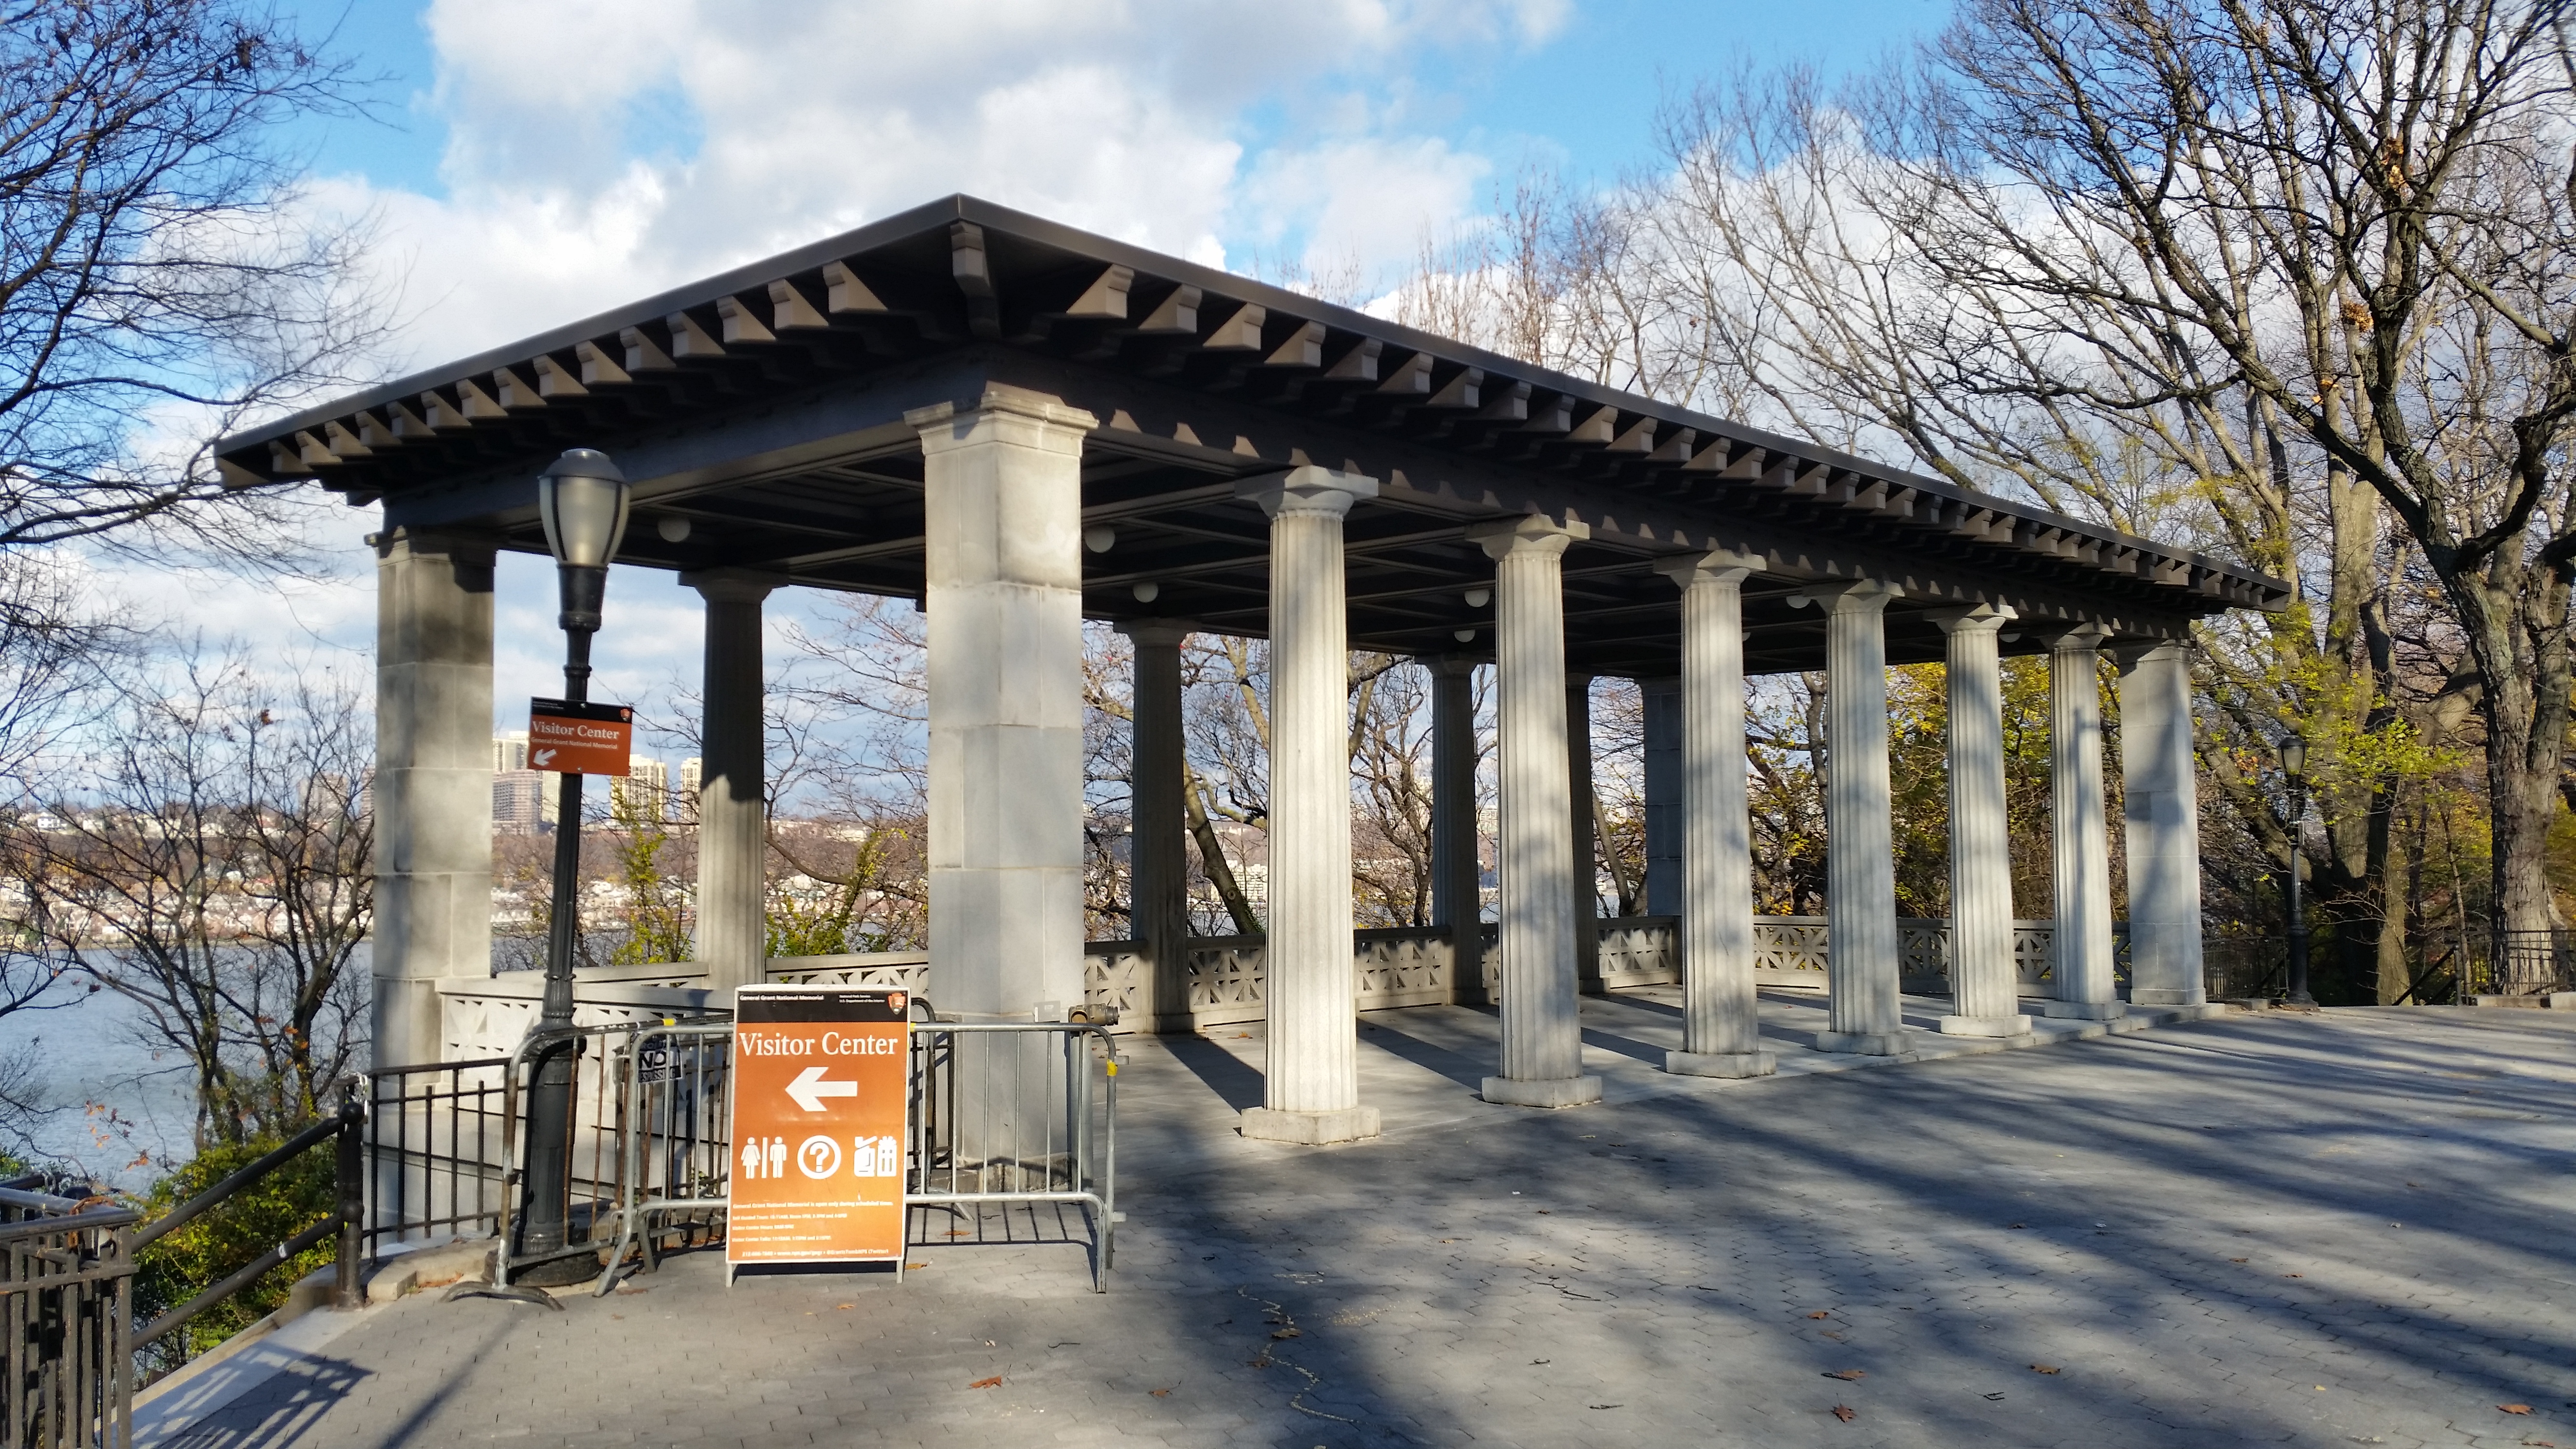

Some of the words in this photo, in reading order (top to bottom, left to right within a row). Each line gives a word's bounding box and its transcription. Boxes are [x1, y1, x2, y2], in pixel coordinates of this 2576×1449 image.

[533, 721, 574, 735] Visitor
[577, 725, 619, 739] Center
[739, 1032, 815, 1056] Visitor
[822, 1031, 898, 1055] Center
